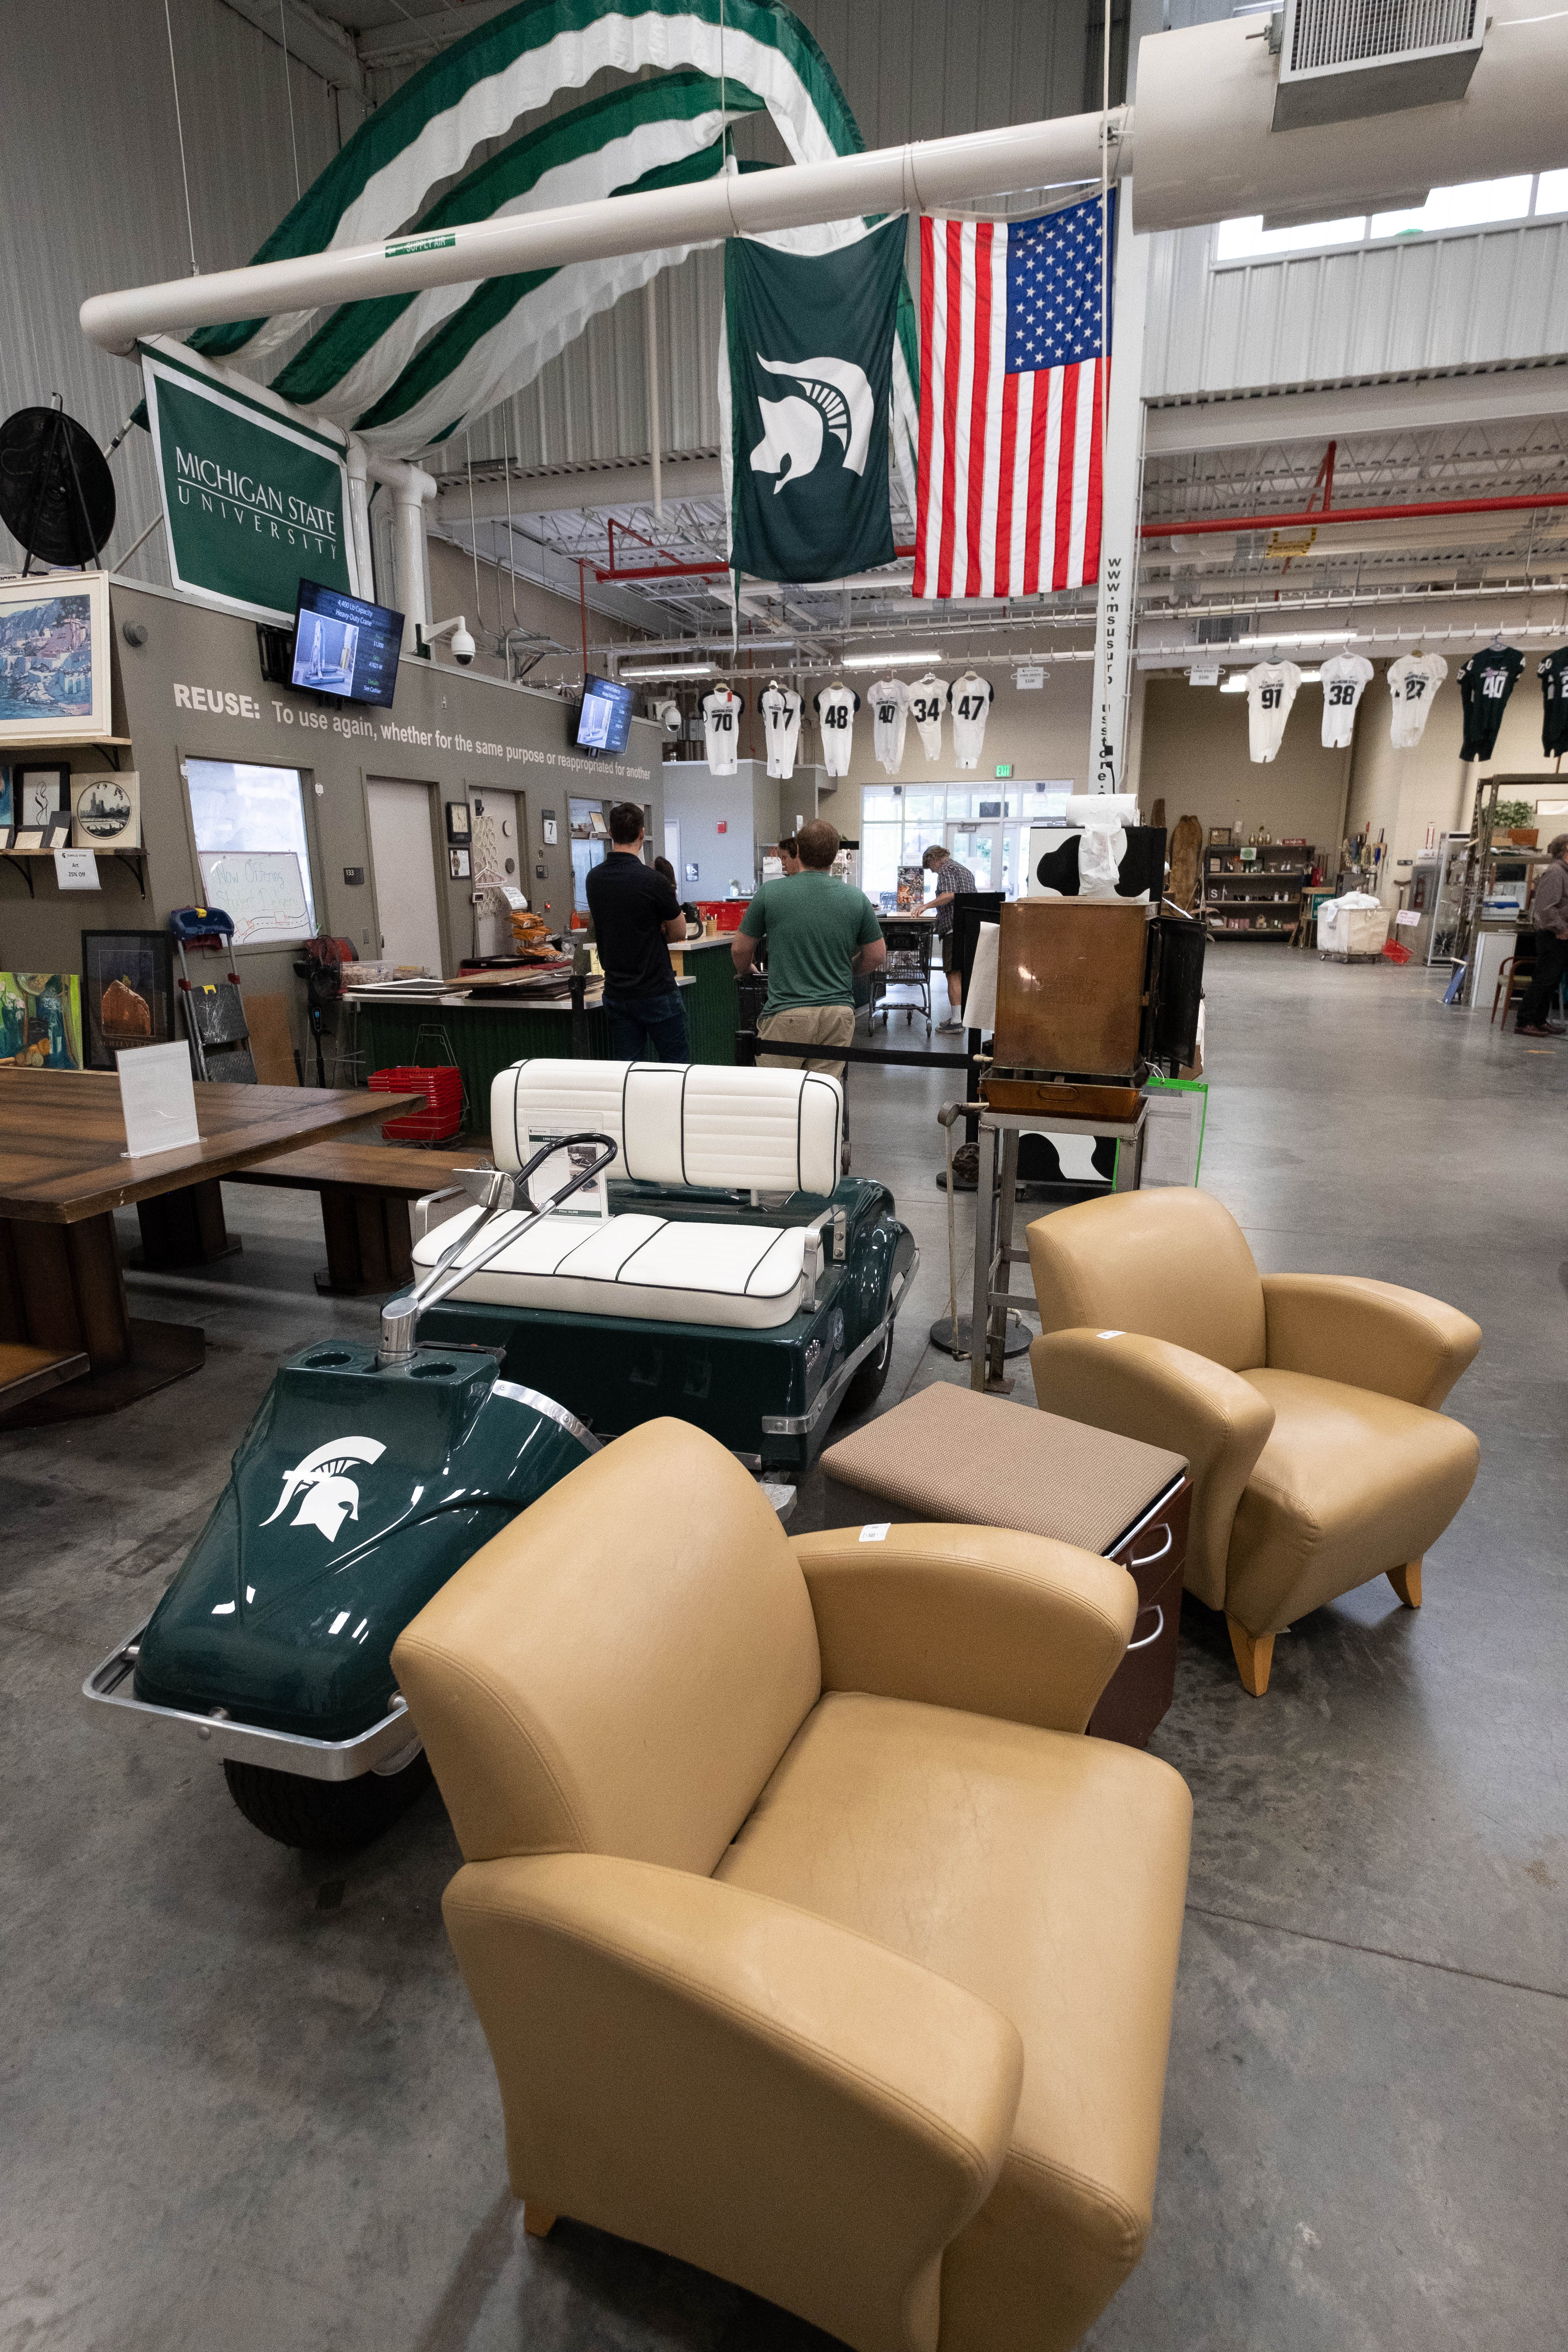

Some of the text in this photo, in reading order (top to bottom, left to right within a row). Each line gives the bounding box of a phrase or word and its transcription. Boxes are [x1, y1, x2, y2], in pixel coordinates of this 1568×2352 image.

[176, 446, 336, 535] MICHIGAN STATE
[178, 485, 337, 559] UNIVERSITY
[336, 609, 372, 626] Heavy-Duty Crane
[338, 599, 349, 608] 4,400
[356, 605, 373, 618] Capacity
[1329, 685, 1355, 706] 38
[1406, 680, 1426, 701] 27
[1483, 675, 1506, 698] 40
[958, 695, 985, 720] 47
[1261, 688, 1281, 709] 91
[825, 705, 848, 729] 48
[879, 705, 896, 724] 40
[914, 698, 939, 723] 34
[174, 683, 651, 780] REUSE: To use again, whether for the same purpose or reappropriated for another
[712, 713, 732, 732] 70
[996, 765, 1010, 777] EXIT
[548, 822, 553, 835] 7
[216, 861, 285, 889] Now Offering
[1210, 889, 1218, 898] S
